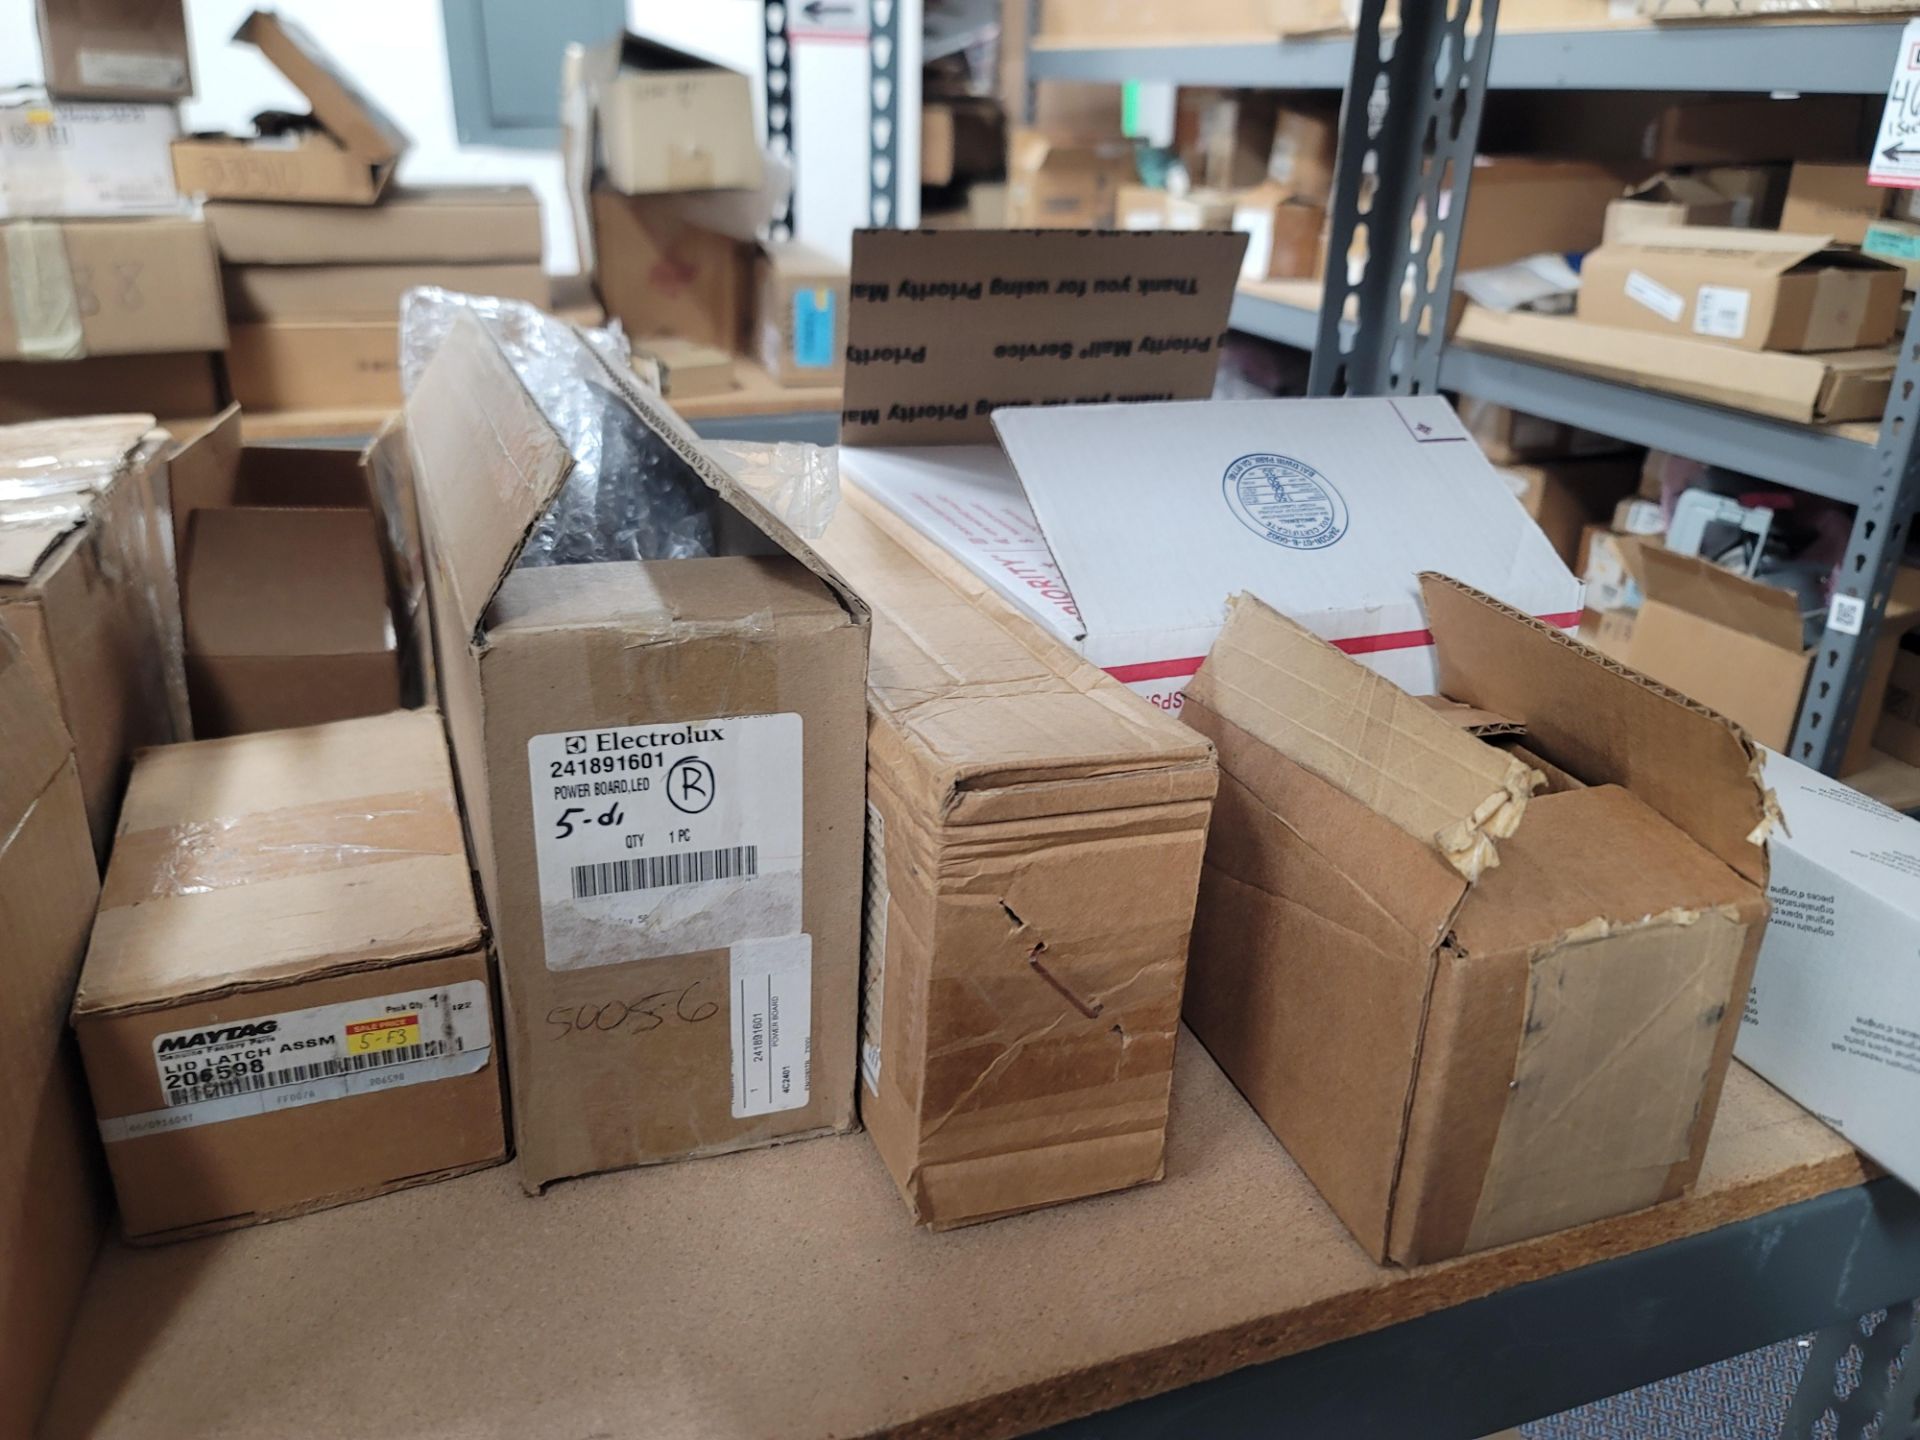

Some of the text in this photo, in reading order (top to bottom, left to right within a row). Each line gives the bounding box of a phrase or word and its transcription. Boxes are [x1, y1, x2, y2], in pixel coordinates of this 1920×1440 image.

[897, 278, 982, 300] Priority
[989, 276, 1050, 299] using
[1056, 278, 1088, 296] for
[1093, 275, 1132, 294] you
[1137, 276, 1198, 296] Thank
[846, 344, 927, 365] Priority
[993, 343, 1074, 361] Service
[1138, 335, 1211, 354] Priority
[886, 402, 968, 421] Priority
[1266, 521, 1320, 537] CERTIFICATE
[596, 726, 725, 753] Electrolux
[550, 752, 664, 778] 241891601
[554, 777, 650, 801] POWER BOARD,LED
[625, 828, 691, 849] QTY 1 PC
[1806, 892, 1835, 905] pieces
[1780, 911, 1804, 920] spare
[386, 1004, 406, 1014] Pack
[379, 1018, 407, 1029] PRICE
[771, 996, 779, 1048] POWER BOARD
[158, 1020, 278, 1053] MAYTAG
[753, 1012, 763, 1063] 241891601
[159, 1035, 276, 1062] Genuine Factory Parts
[164, 1034, 335, 1075] LID LATCH ASSM
[165, 1059, 265, 1090] 206598
